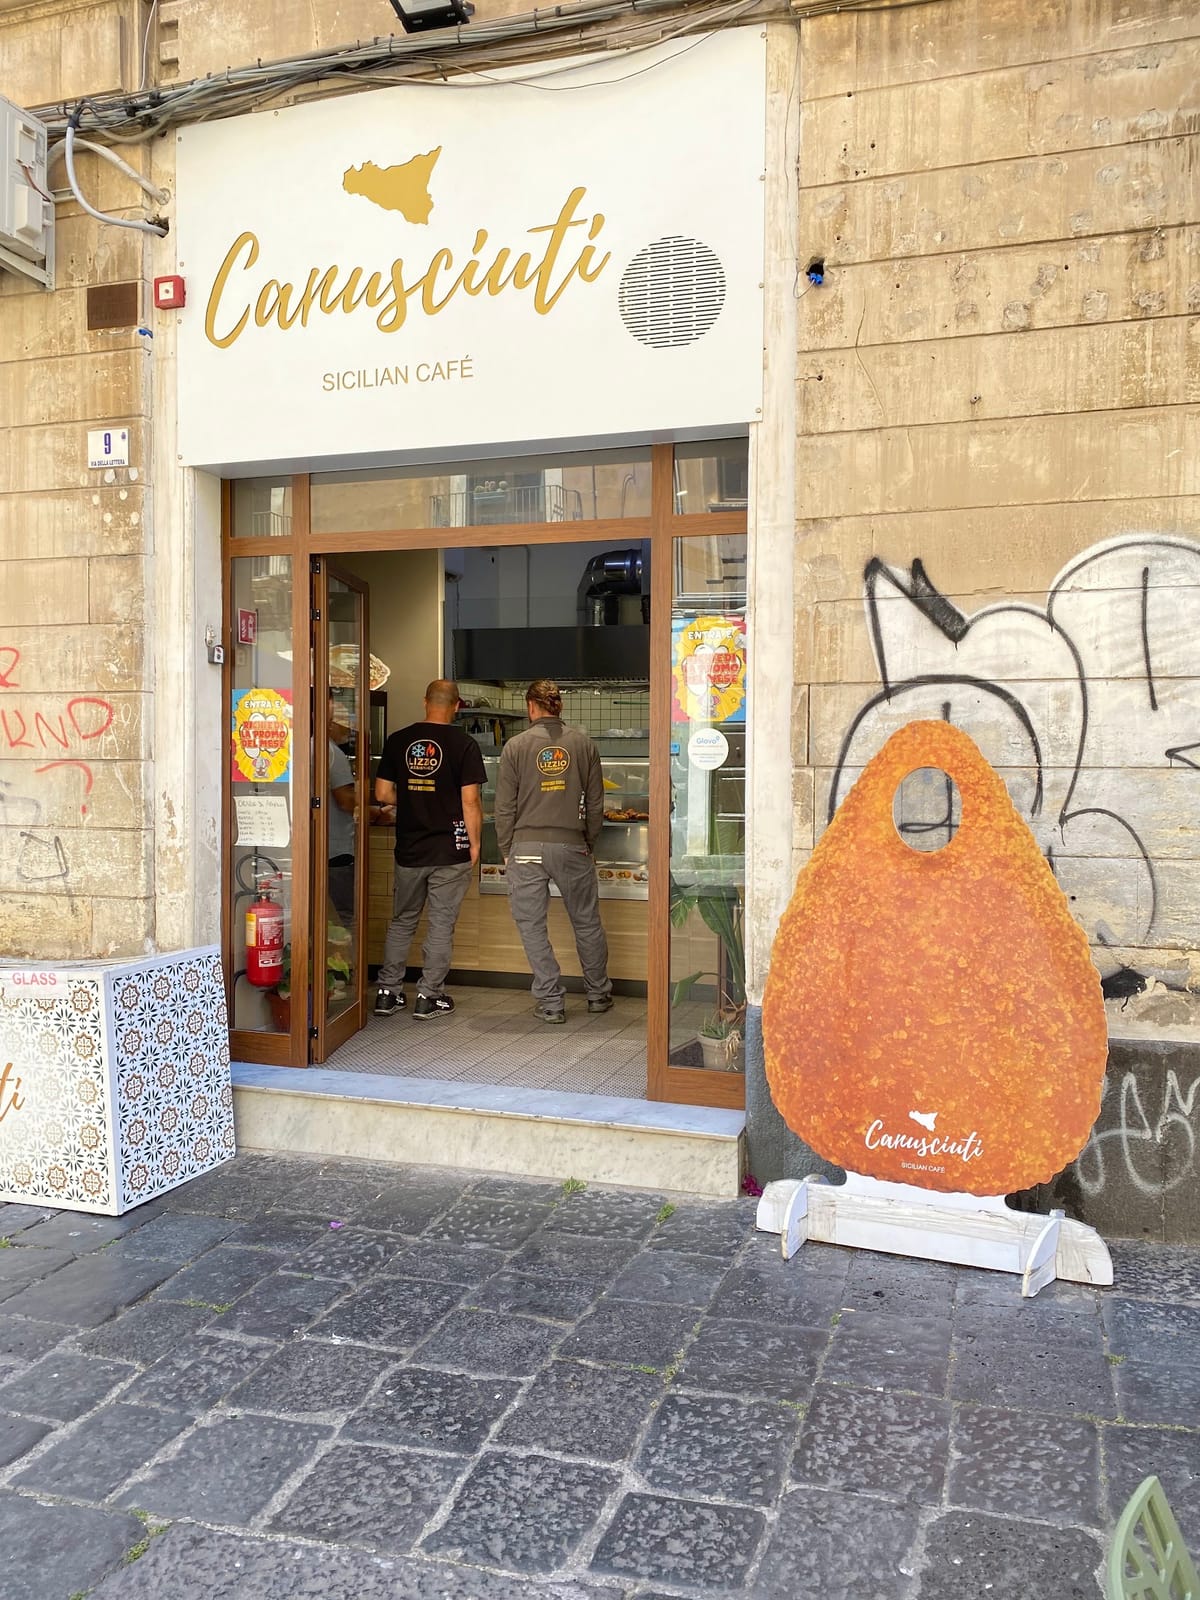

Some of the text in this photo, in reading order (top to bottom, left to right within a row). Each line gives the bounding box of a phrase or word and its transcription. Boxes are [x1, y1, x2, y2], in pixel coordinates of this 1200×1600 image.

[322, 354, 474, 391] SICILIAN CAFÉ
[104, 433, 111, 454] 9
[688, 631, 722, 640] ENTRA
[244, 700, 281, 709] ENTRA E
[243, 721, 285, 730] RICHIEDI
[241, 730, 286, 739] LA PROMO
[241, 739, 285, 749] DEL MESE
[12, 972, 57, 986] GLASS
[901, 1162, 928, 1171] SICILIAN
